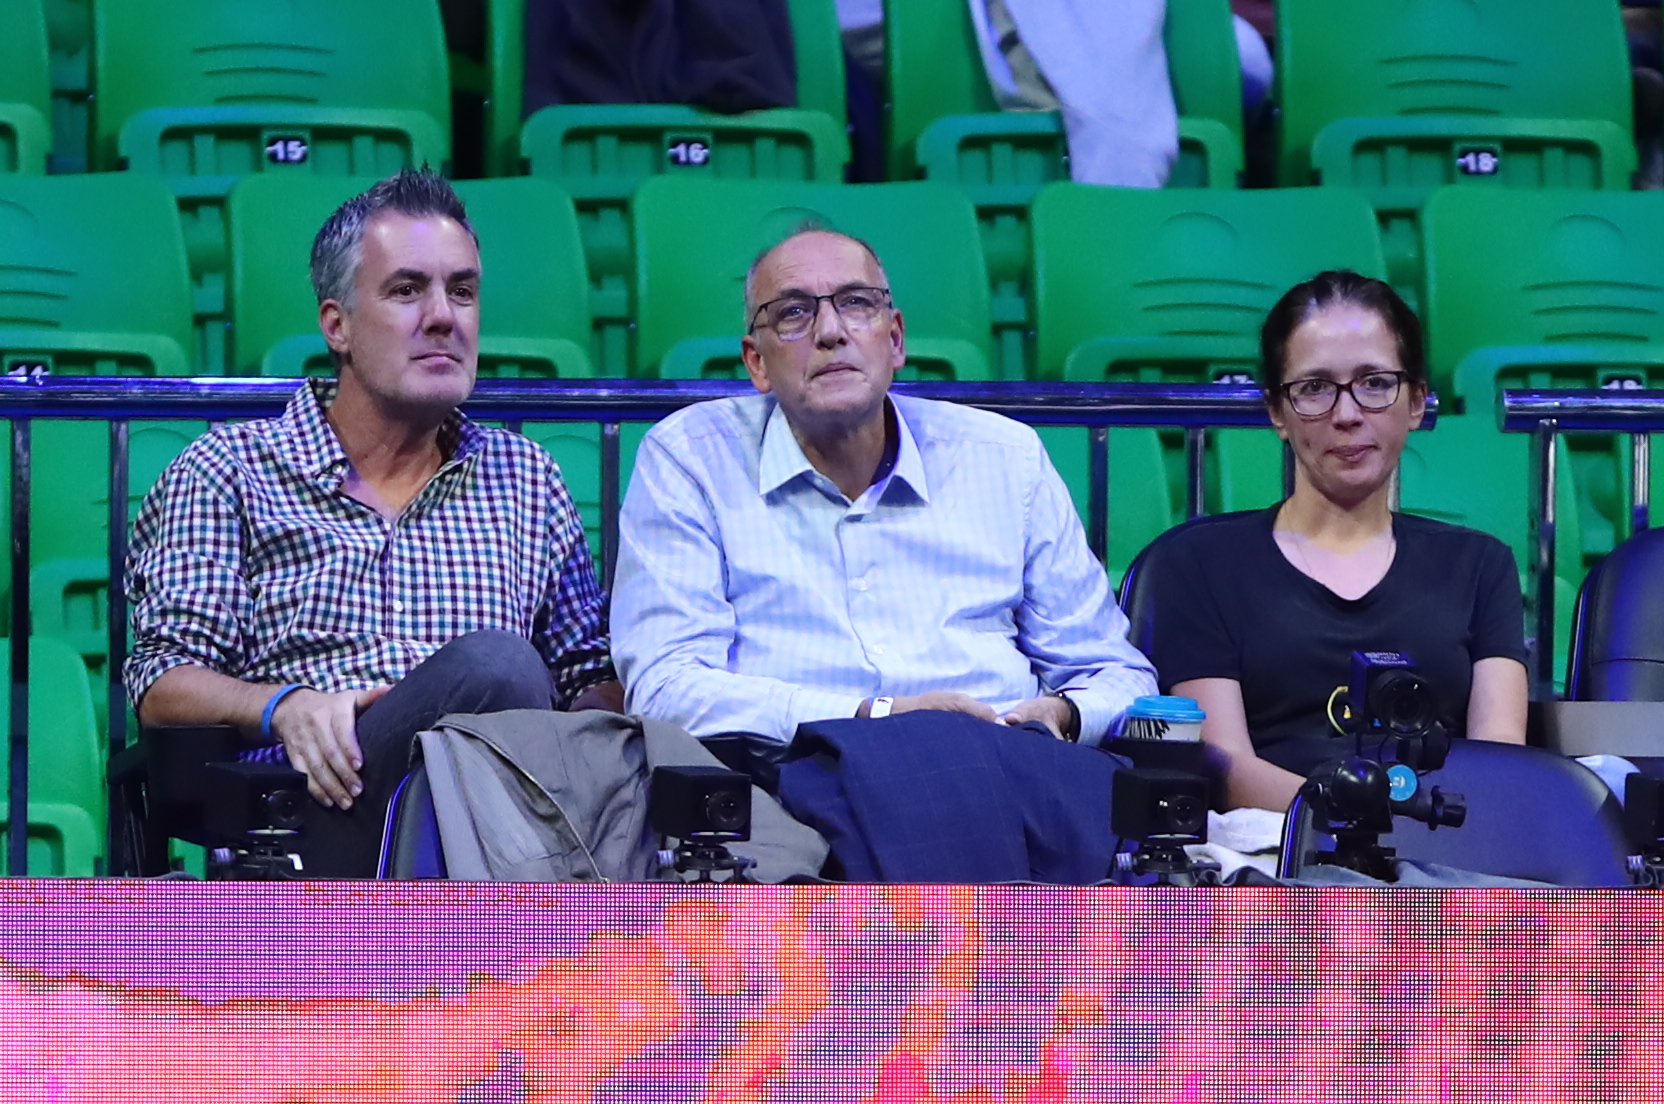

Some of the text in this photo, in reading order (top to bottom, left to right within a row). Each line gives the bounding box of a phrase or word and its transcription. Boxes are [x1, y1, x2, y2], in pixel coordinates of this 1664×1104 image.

[272, 140, 303, 160] 15
[676, 142, 706, 163] 16
[1464, 152, 1494, 172] 18
